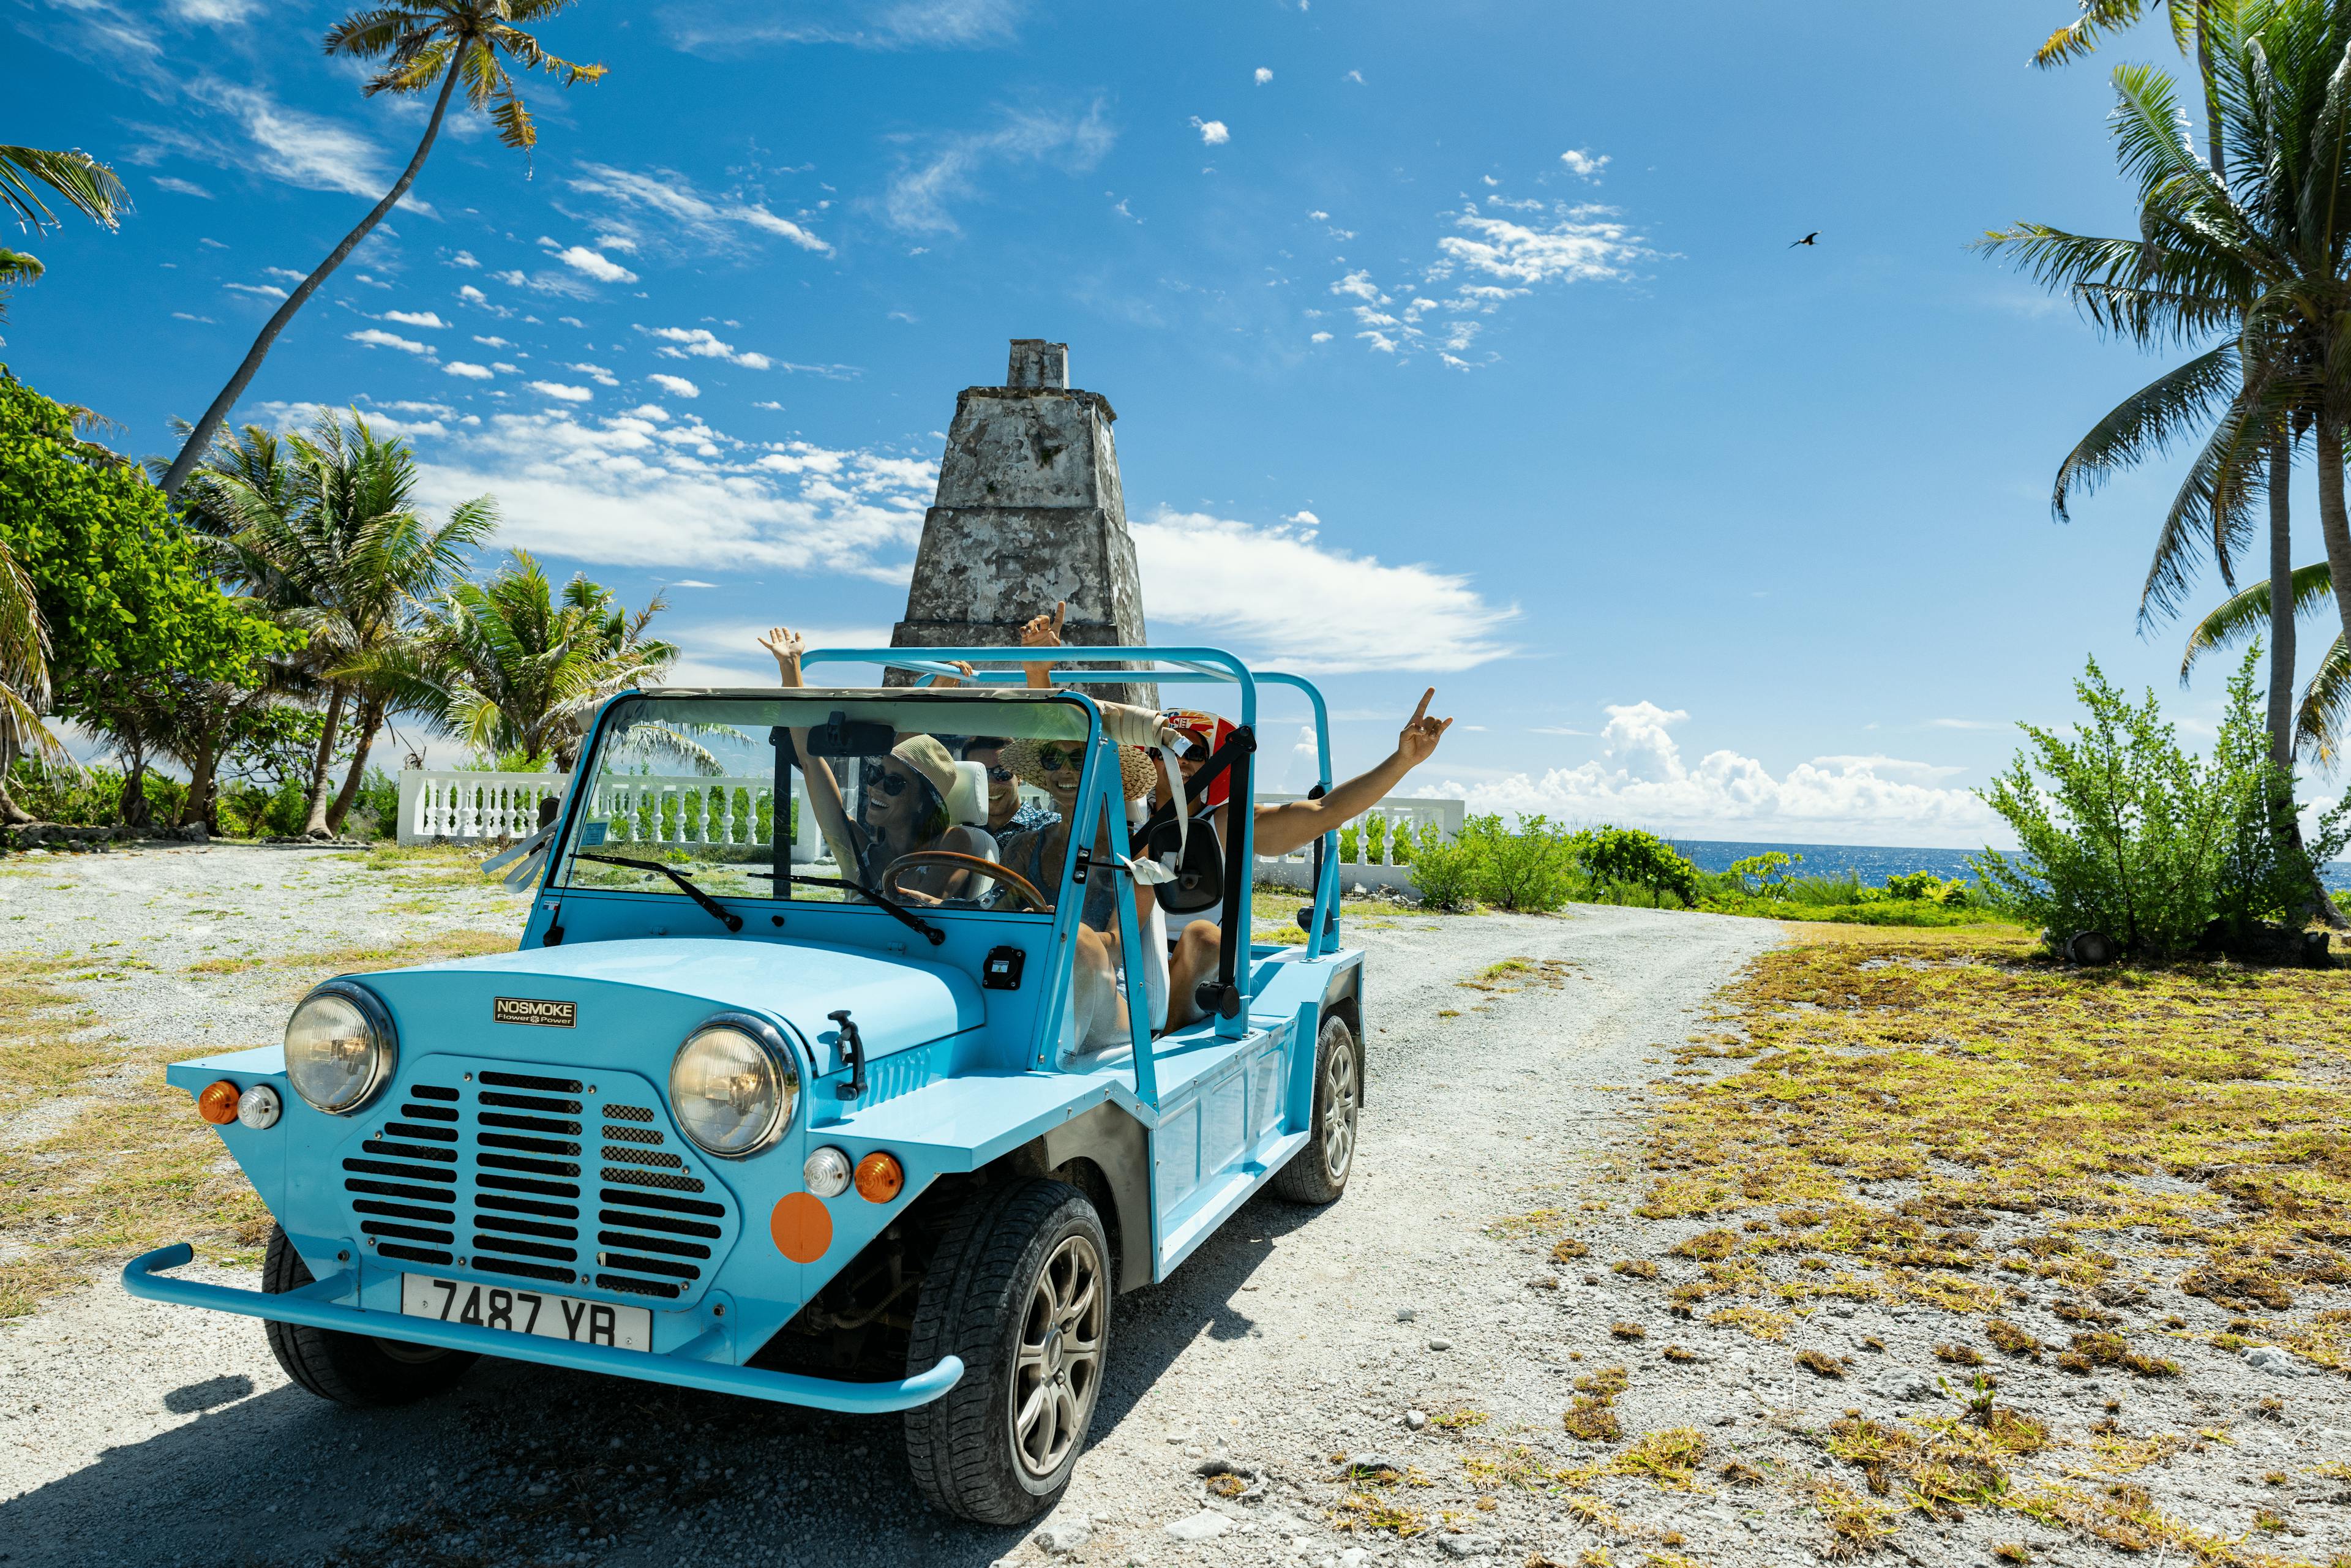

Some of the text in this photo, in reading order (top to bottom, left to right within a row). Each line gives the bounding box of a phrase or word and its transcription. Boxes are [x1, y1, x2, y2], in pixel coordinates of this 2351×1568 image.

[497, 1000, 572, 1018] NOSMOKE
[497, 1013, 530, 1022] Flower
[433, 1279, 542, 1335] 7487
